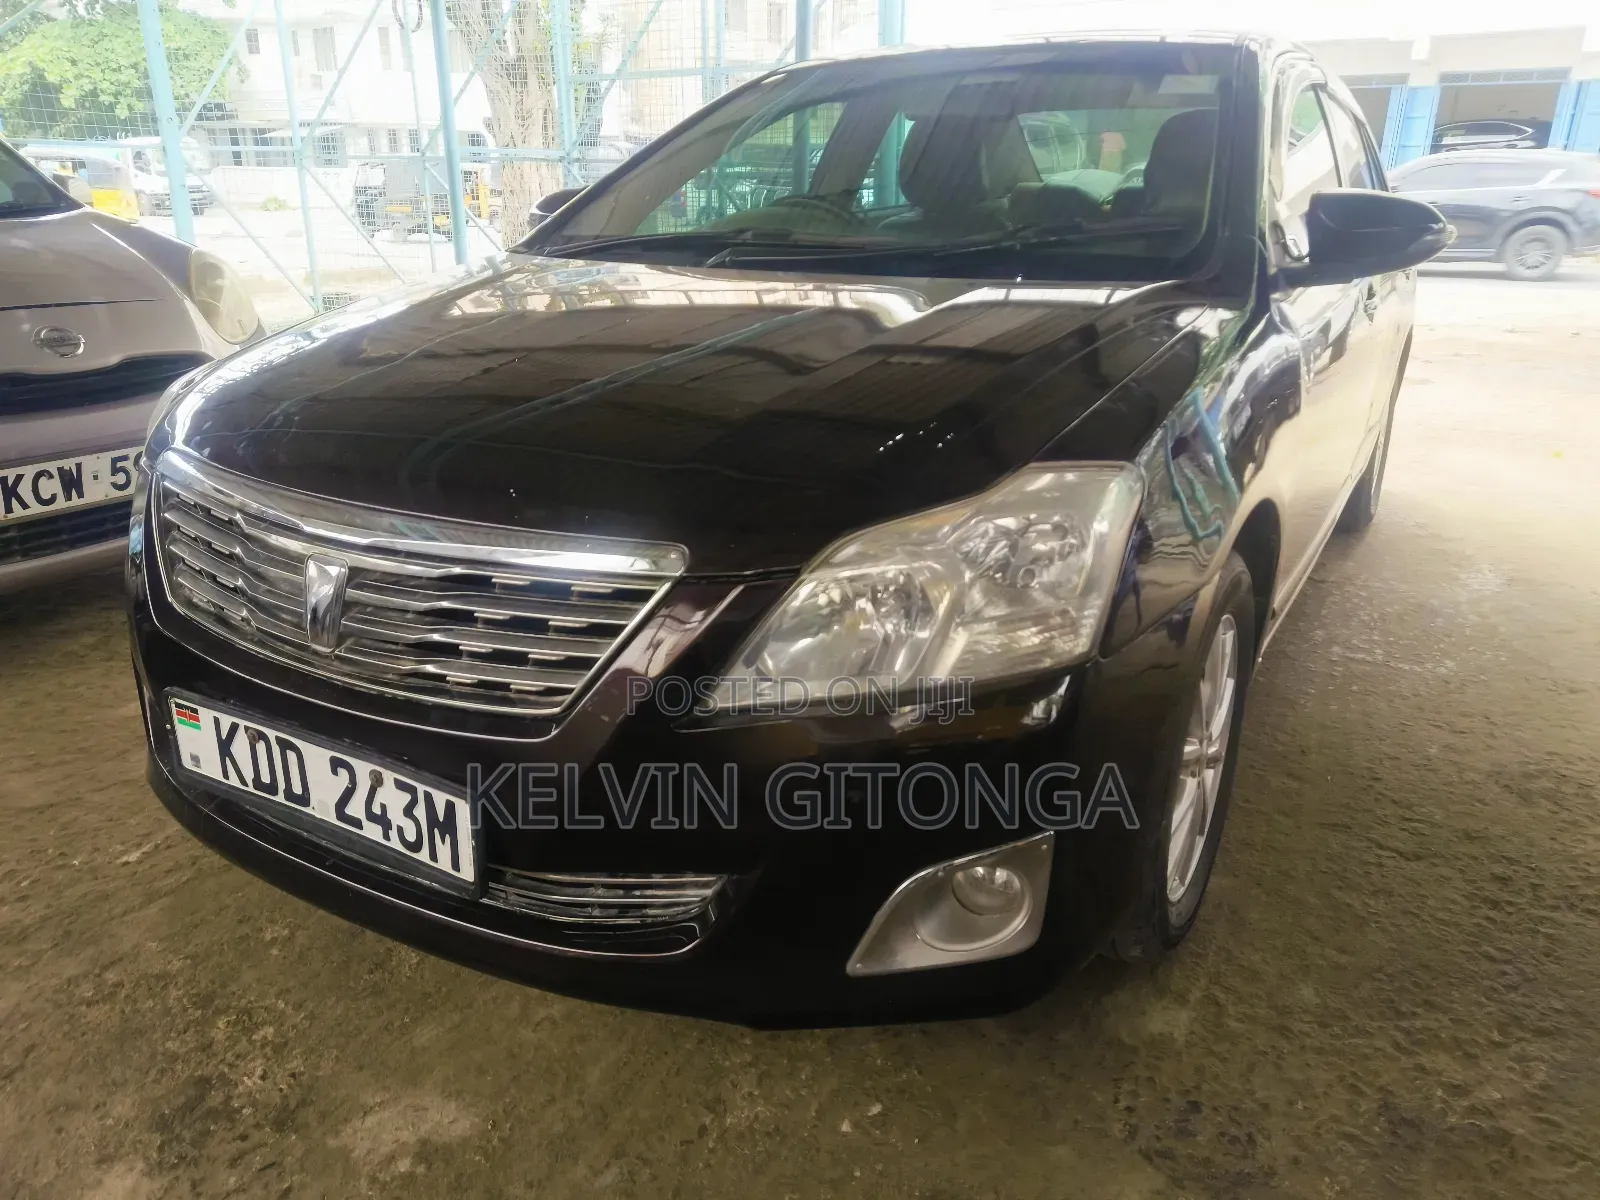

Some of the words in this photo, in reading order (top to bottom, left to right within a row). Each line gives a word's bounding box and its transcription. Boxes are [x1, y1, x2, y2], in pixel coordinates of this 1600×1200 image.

[0, 462, 85, 514] KCW
[110, 450, 144, 491] 5
[213, 715, 311, 808] KDD
[329, 755, 461, 873] 243M
